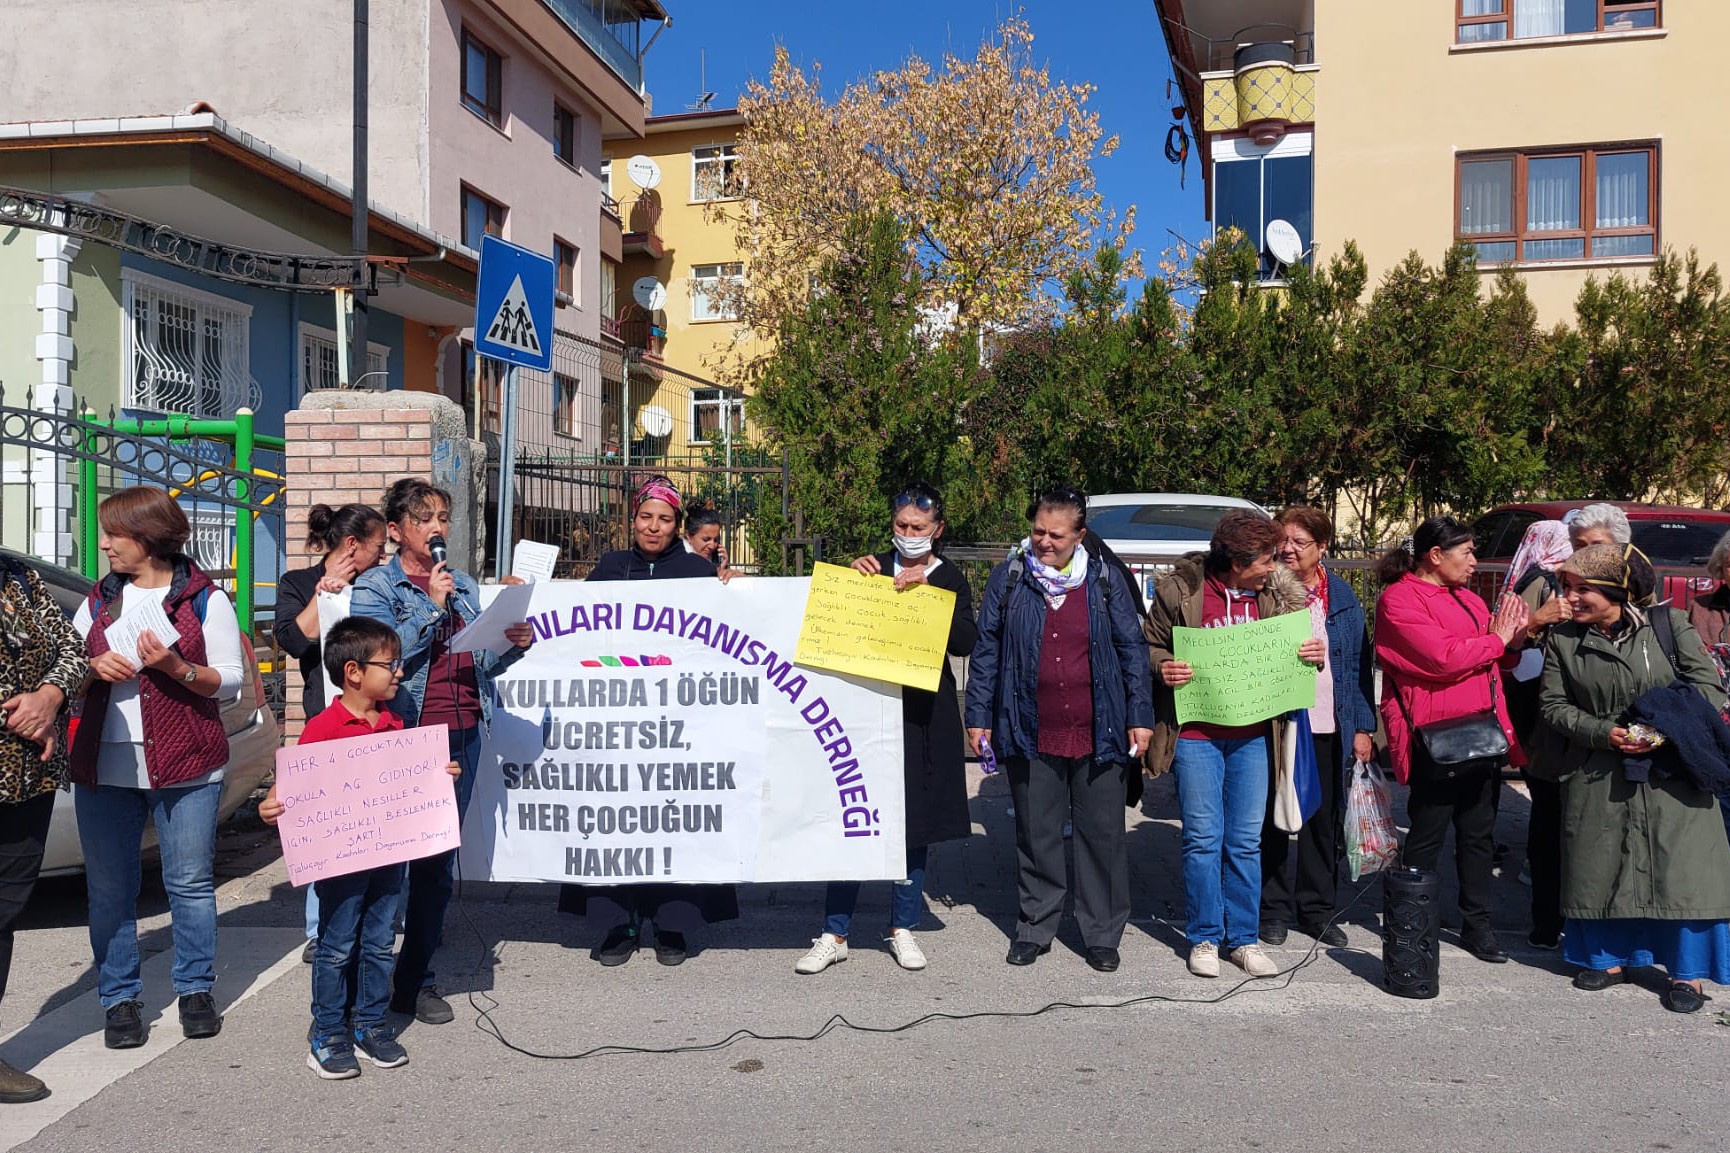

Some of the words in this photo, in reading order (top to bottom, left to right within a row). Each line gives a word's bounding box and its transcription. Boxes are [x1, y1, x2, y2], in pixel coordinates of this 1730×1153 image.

[498, 678, 648, 708] KULLARDA
[654, 678, 668, 706] 1
[677, 671, 759, 706] ÖĞÜN
[526, 603, 622, 643] NLARI
[800, 696, 881, 837] DERNEĞİ
[543, 715, 691, 751] ÜCRETSİZ,
[287, 756, 319, 776] HER
[329, 752, 336, 764] 4
[502, 757, 628, 791] SAĞLIKLI
[637, 762, 737, 792] YEMEK
[285, 788, 327, 809] OKULA
[385, 797, 452, 821] BESLENMEK
[295, 804, 351, 828] SAĞLIKLI
[518, 803, 569, 832] HER
[577, 798, 723, 839] ÇOCUĞUN
[565, 847, 654, 876] HAKKI
